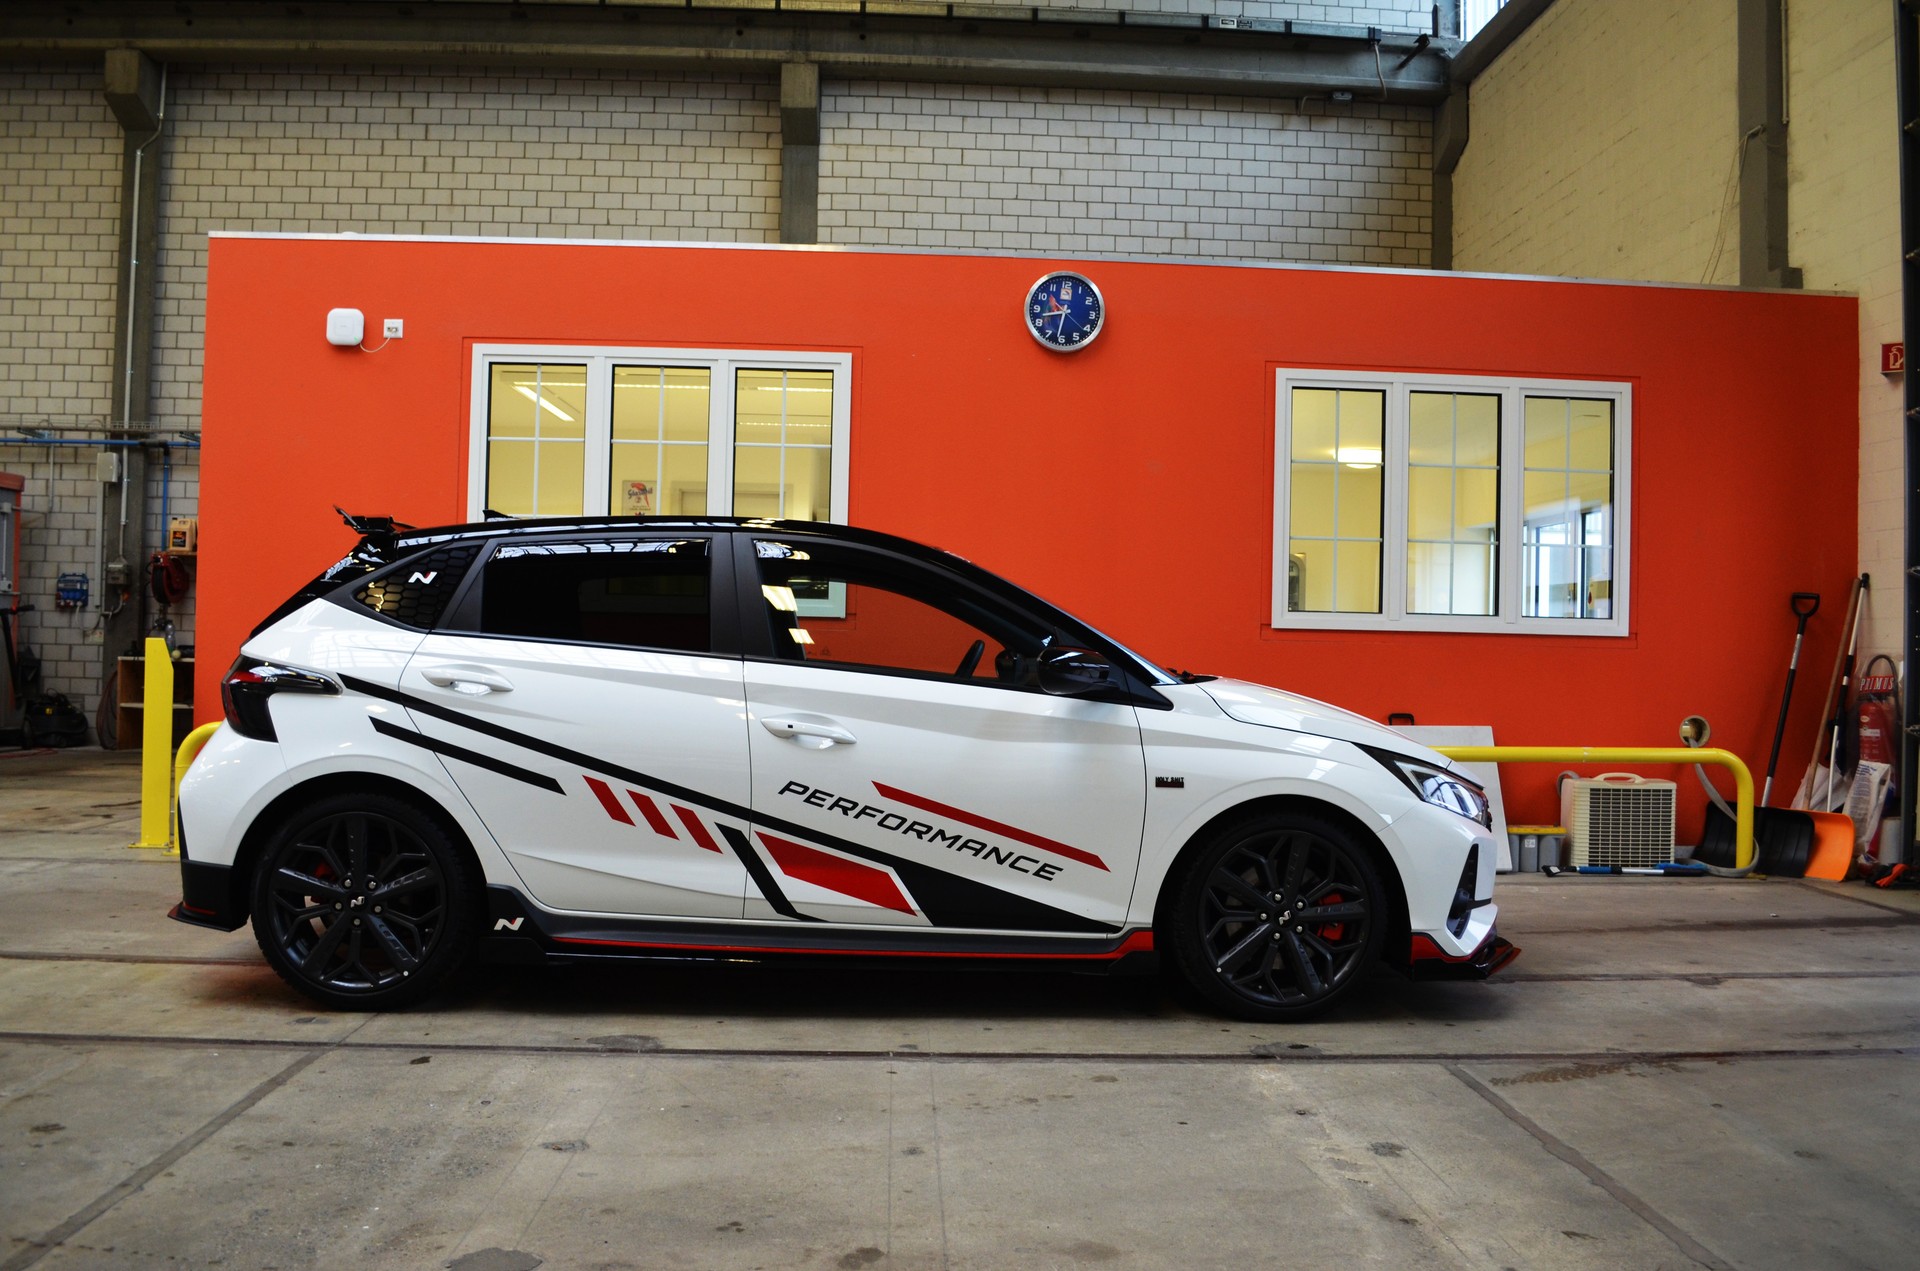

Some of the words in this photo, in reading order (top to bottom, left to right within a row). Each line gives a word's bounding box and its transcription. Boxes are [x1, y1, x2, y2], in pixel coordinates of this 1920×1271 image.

[1050, 284, 1056, 292] 11
[1062, 281, 1072, 289] 12
[1078, 286, 1082, 294] 1
[1038, 293, 1047, 301] 10
[1085, 297, 1093, 305] 2
[1033, 305, 1041, 313] 9
[1088, 311, 1096, 319] 3
[1035, 319, 1043, 327] 8
[1045, 330, 1052, 338] 7
[1072, 333, 1080, 341] 5
[1058, 335, 1066, 343] 6
[408, 571, 438, 585] N
[1860, 677, 1893, 691] PRIMUS
[777, 780, 1064, 882] PERFORMANCE
[493, 917, 525, 931] N
